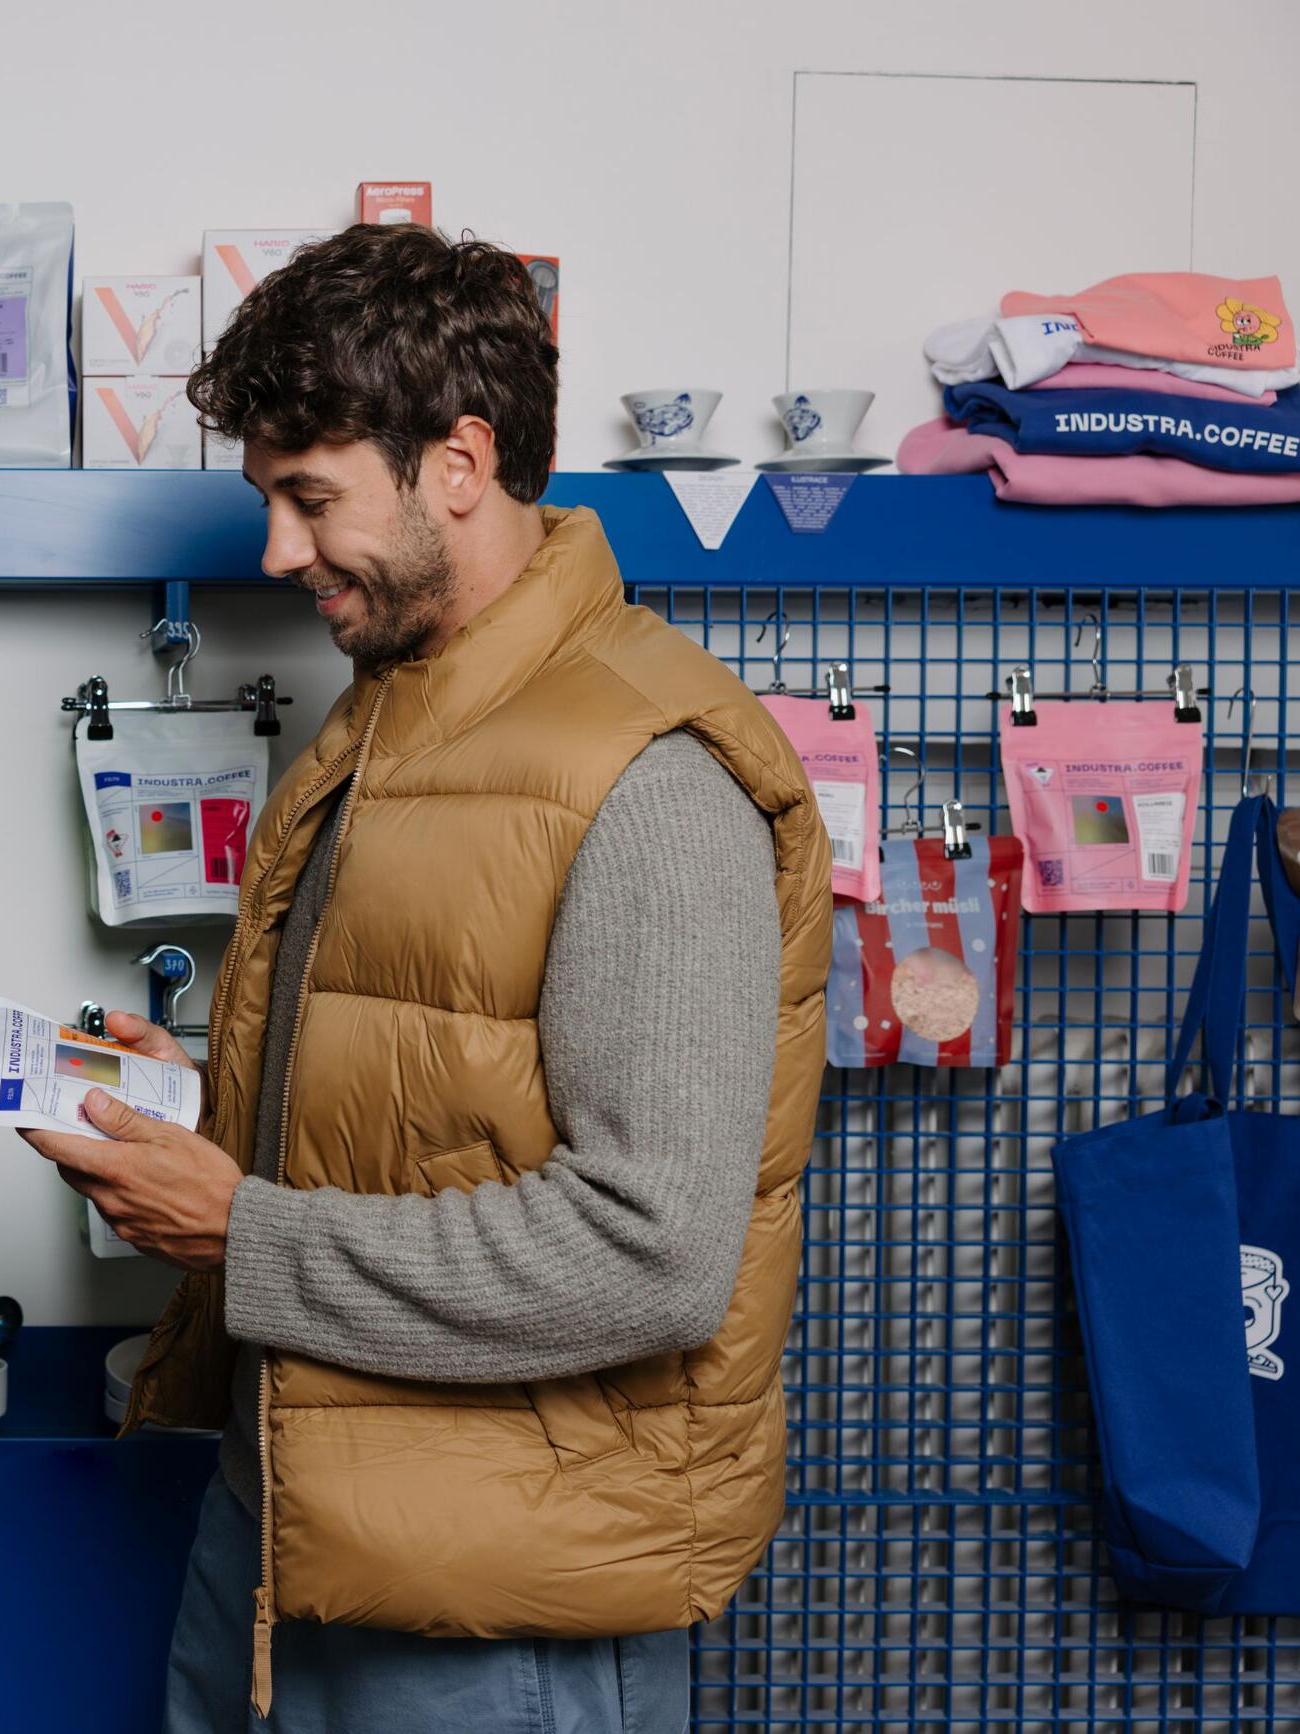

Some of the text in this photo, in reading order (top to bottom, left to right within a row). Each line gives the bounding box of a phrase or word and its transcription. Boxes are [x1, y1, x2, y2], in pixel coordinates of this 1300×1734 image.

[365, 186, 424, 196] AeroPress
[1054, 412, 1300, 458] INDUSTRA.COFFEE
[1065, 761, 1184, 774] INDUSTRA.COFFEE
[137, 769, 251, 787] INDUSTRA.COFFEE
[932, 897, 980, 914] müsli
